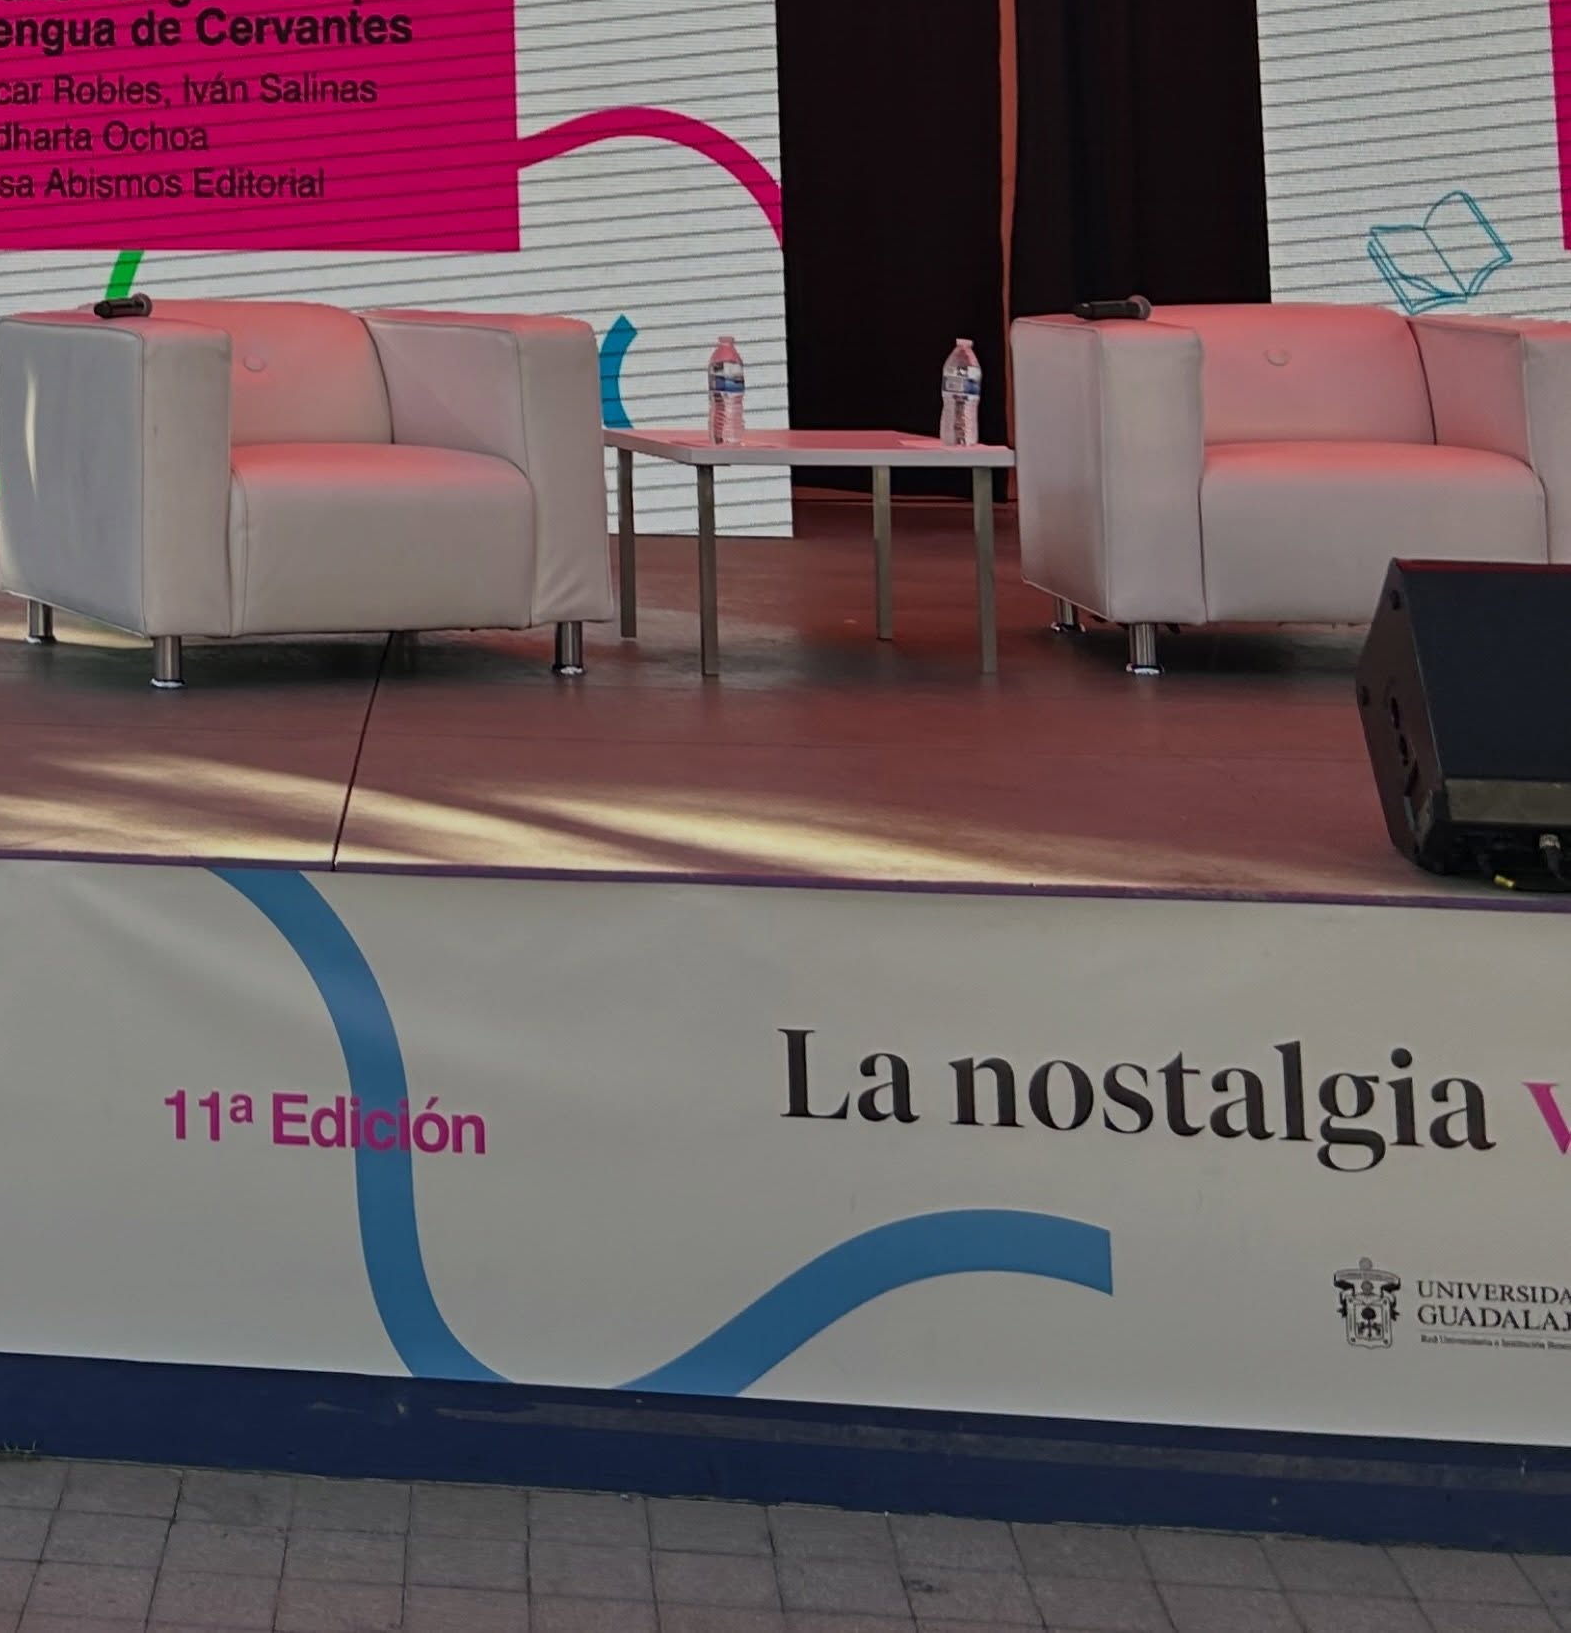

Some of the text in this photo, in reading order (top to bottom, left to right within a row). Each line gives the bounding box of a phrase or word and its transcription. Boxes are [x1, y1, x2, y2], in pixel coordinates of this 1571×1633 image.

[131, 9, 182, 47] de
[195, 7, 414, 46] Cervantes
[53, 73, 172, 112] Robles,
[183, 72, 250, 104] Iván
[259, 72, 379, 104] Salinas
[102, 121, 210, 153] Ochoa
[44, 168, 183, 199] Abismos
[193, 167, 326, 198] Editorial
[777, 1027, 920, 1124] La
[948, 1040, 1497, 1173] nostalgia
[271, 1092, 487, 1156] Edición
